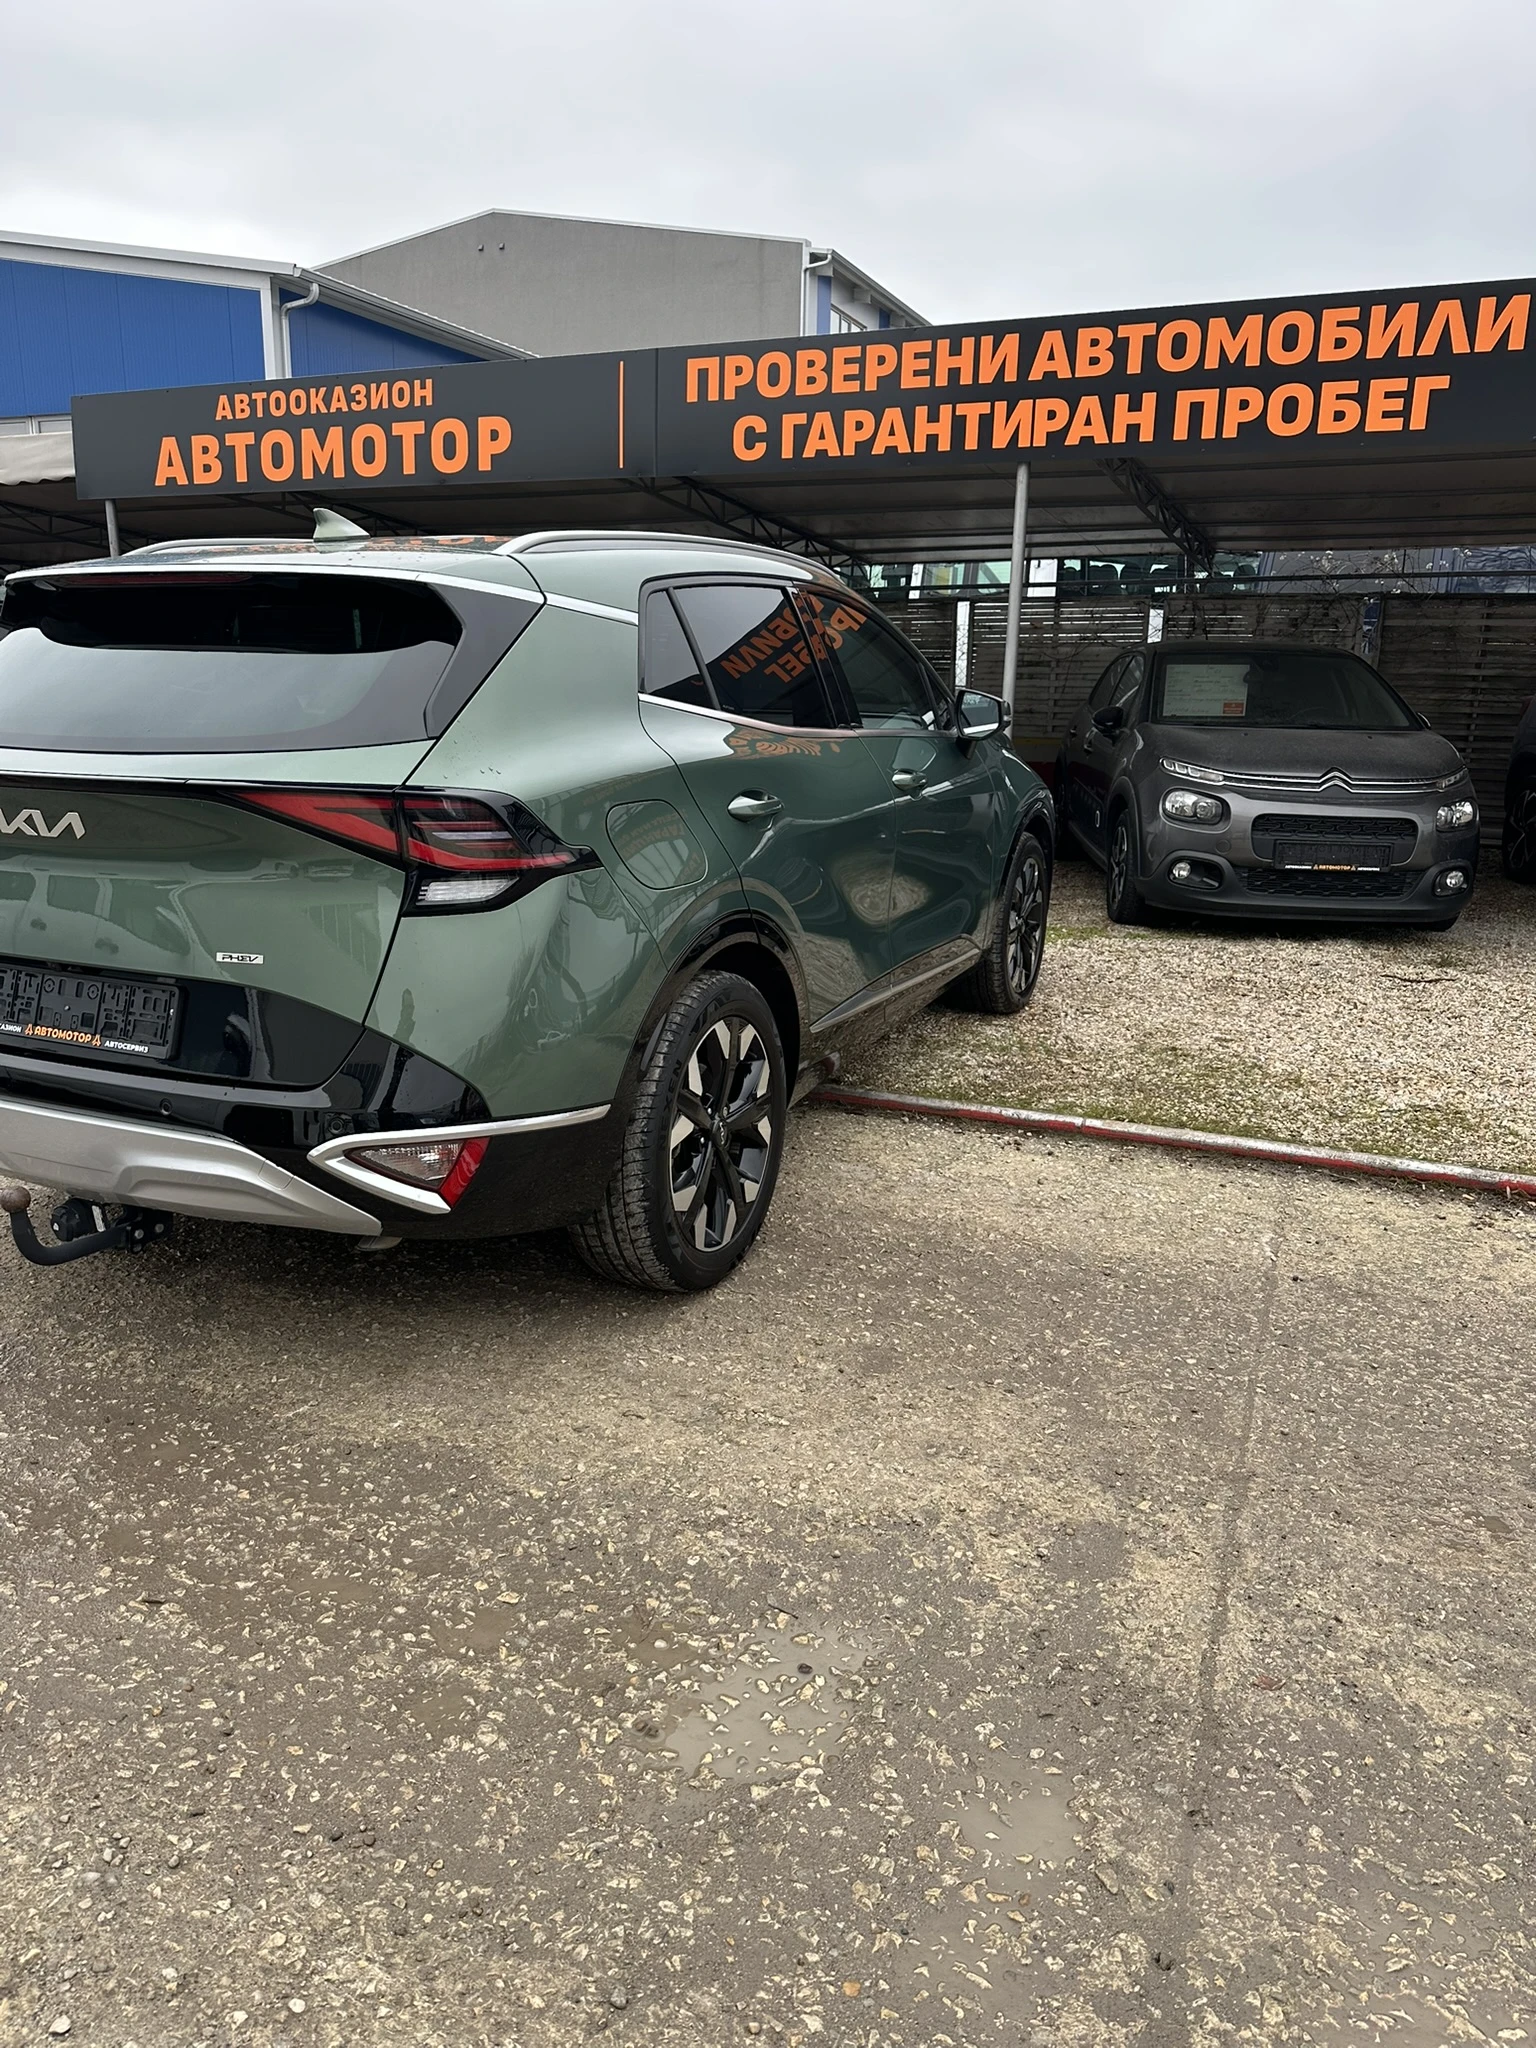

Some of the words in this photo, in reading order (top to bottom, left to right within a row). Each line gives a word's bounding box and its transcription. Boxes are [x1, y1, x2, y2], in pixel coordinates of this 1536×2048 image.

[686, 333, 1020, 403] ПРОВЕРЕНИ
[1027, 294, 1531, 381] АВТОМОБИЛИ
[215, 378, 433, 421] АВТООКАЗИОН
[732, 415, 768, 461] С
[781, 391, 1157, 459] ГАРАНТИРАН
[1172, 375, 1451, 441] ПРОБЕГ
[154, 415, 512, 487] АВТОМОТОР
[222, 954, 259, 963] PHEV
[34, 1025, 92, 1043] АВТОМОТОР
[104, 1040, 149, 1054] АВТОСЕРВИЗ
